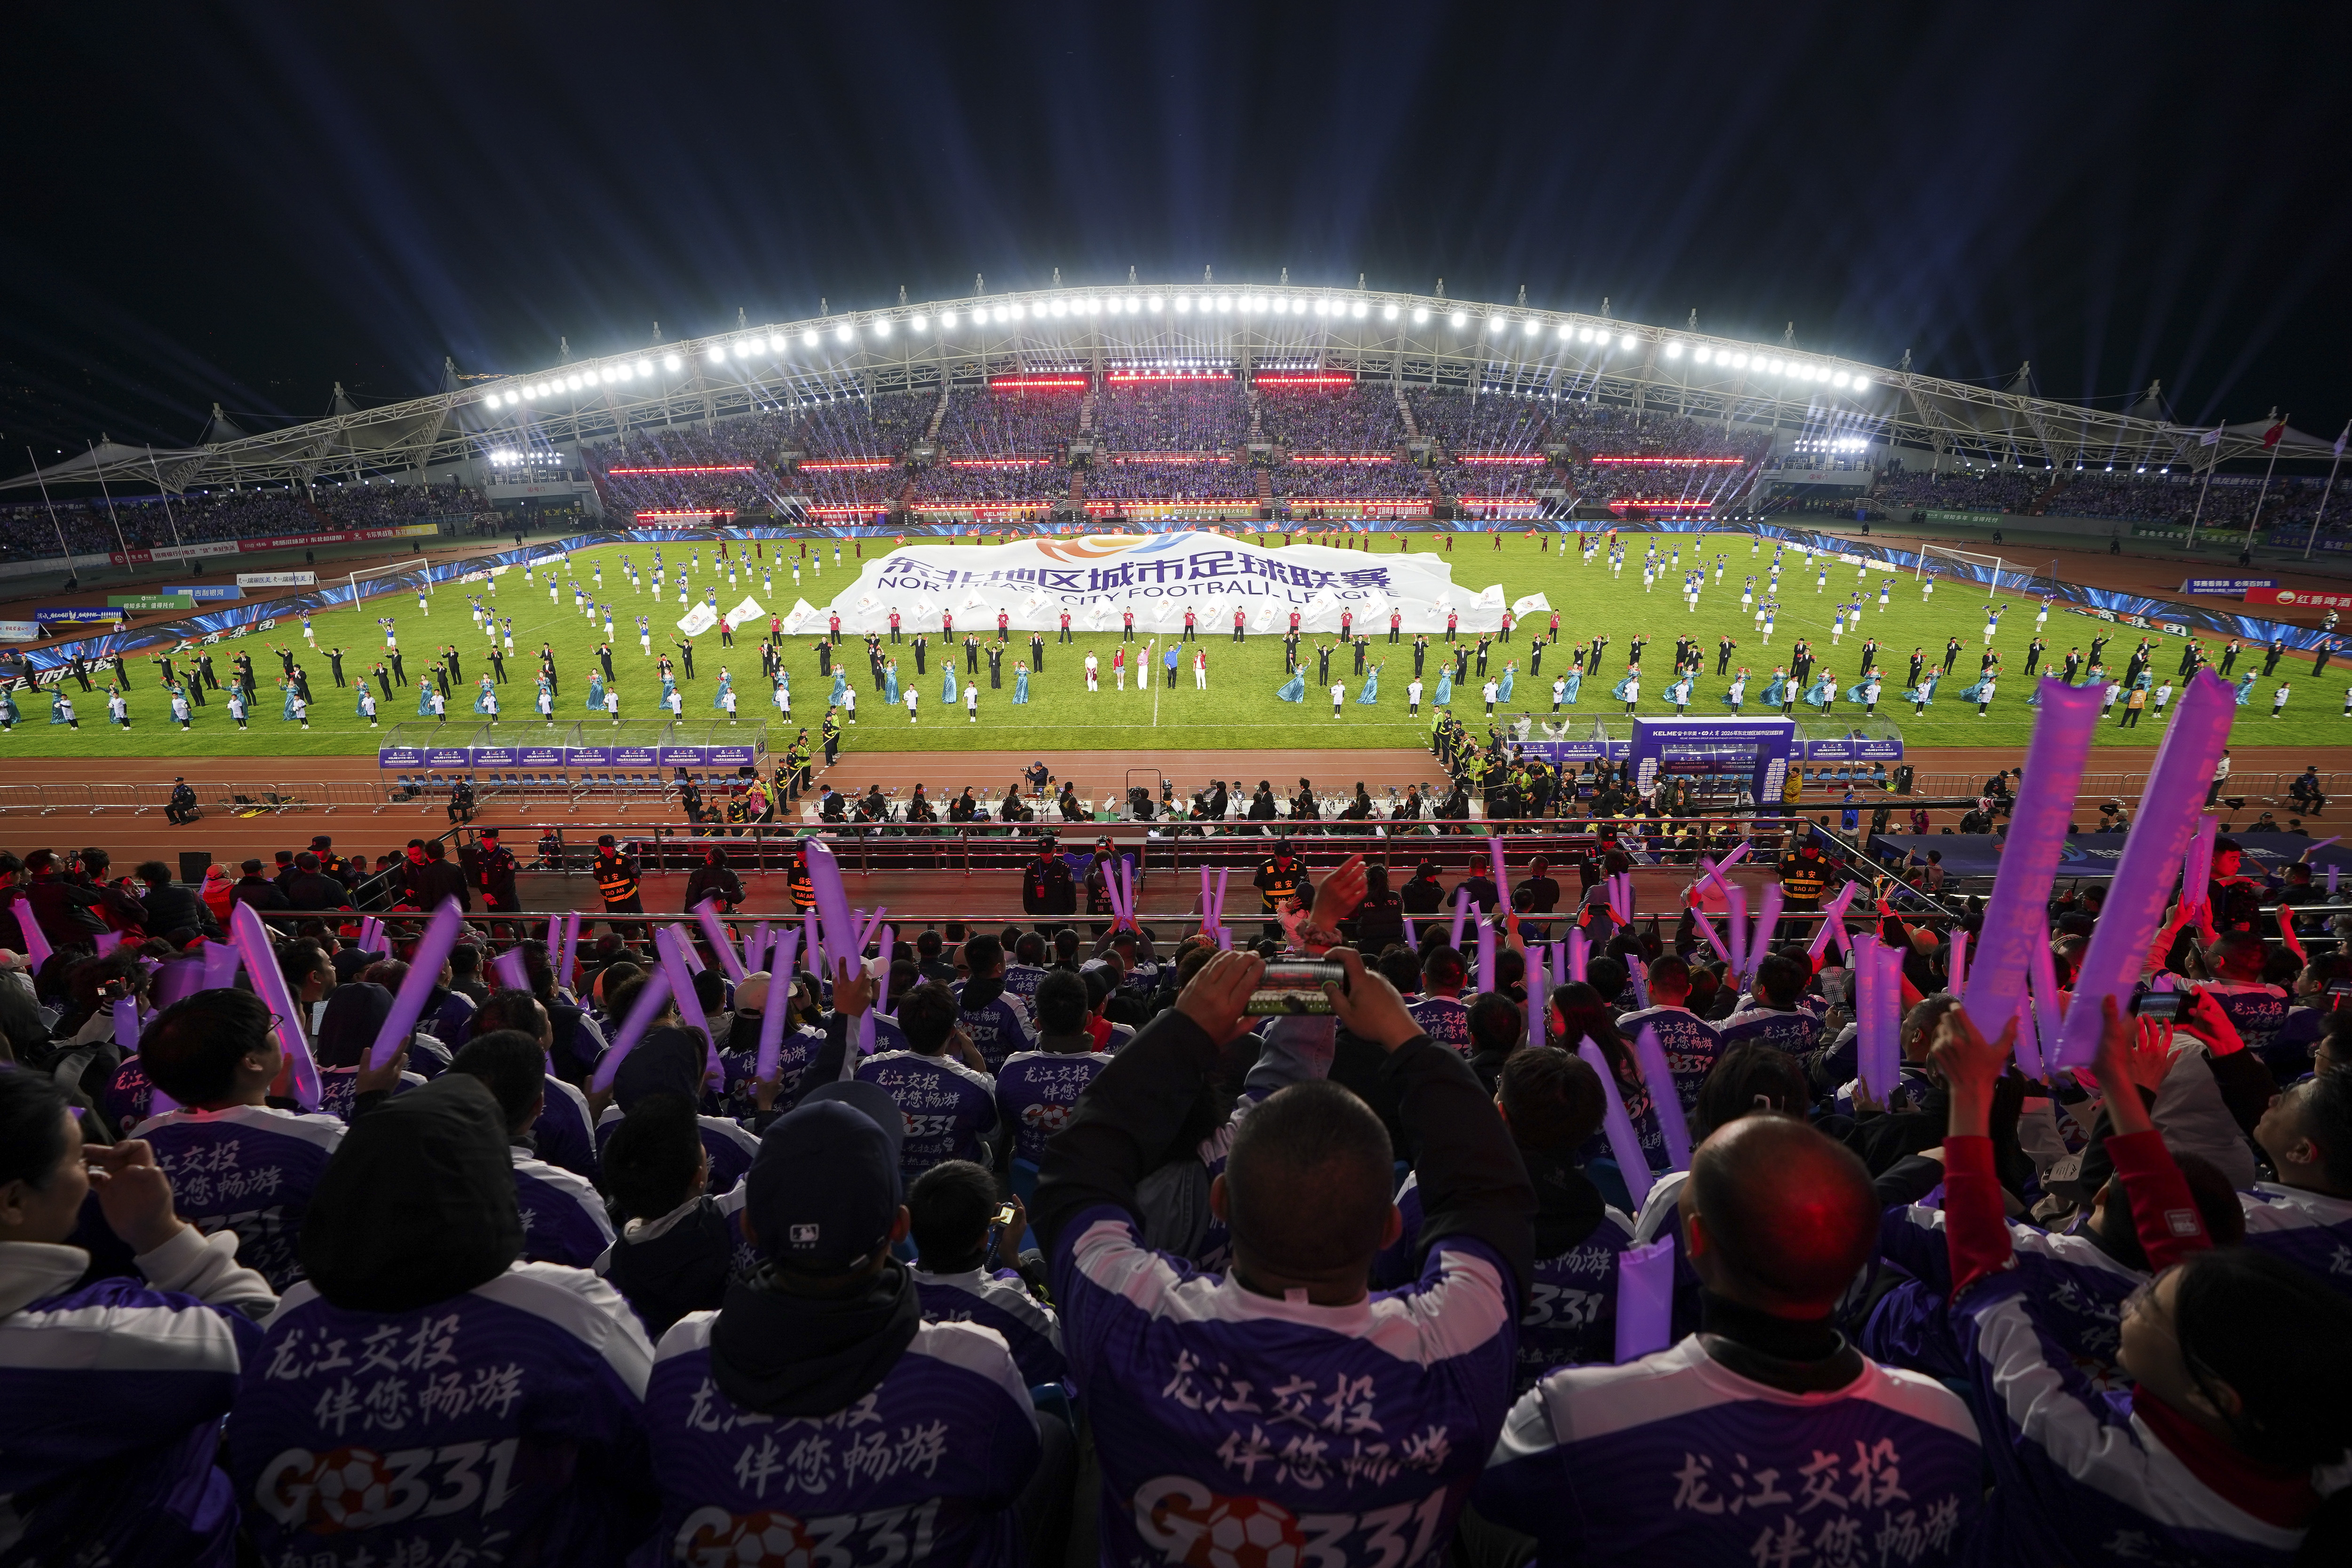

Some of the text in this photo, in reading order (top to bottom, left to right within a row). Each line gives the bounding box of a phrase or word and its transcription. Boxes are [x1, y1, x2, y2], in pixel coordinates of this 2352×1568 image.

[882, 550, 1396, 593] 东北地区城市足球联赛
[2296, 594, 2352, 608] 红爵啤酒
[171, 619, 276, 654] 大商集团
[603, 873, 619, 883] 保安
[799, 876, 812, 885] 保安
[1796, 870, 1816, 878] 保安
[1274, 880, 1292, 889] 保安
[1006, 972, 1043, 982] 龙江交投
[964, 1011, 1001, 1024] 伴您畅游
[1414, 1010, 1467, 1025] 龙江交投
[2231, 1002, 2284, 1017] 龙江交投
[1763, 1020, 1810, 1039] 龙江交投
[874, 1035, 890, 1050] 游
[1663, 1035, 1713, 1051] 伴您畅游
[876, 1068, 940, 1090] 龙江交投
[1024, 1064, 1090, 1082] 龙江交投
[891, 1088, 961, 1110] 伴您畅游
[902, 1144, 941, 1154] 光拉满
[265, 1313, 461, 1380] 龙江交投
[313, 1362, 525, 1437] 伴您畅游
[1162, 1348, 1384, 1436] 龙江交投
[734, 1418, 948, 1500] 伴您畅游
[1217, 1424, 1451, 1489] 伴您畅游
[1673, 1437, 1911, 1516] 龙江交投
[1750, 1492, 1960, 1568] 伴您畅游
